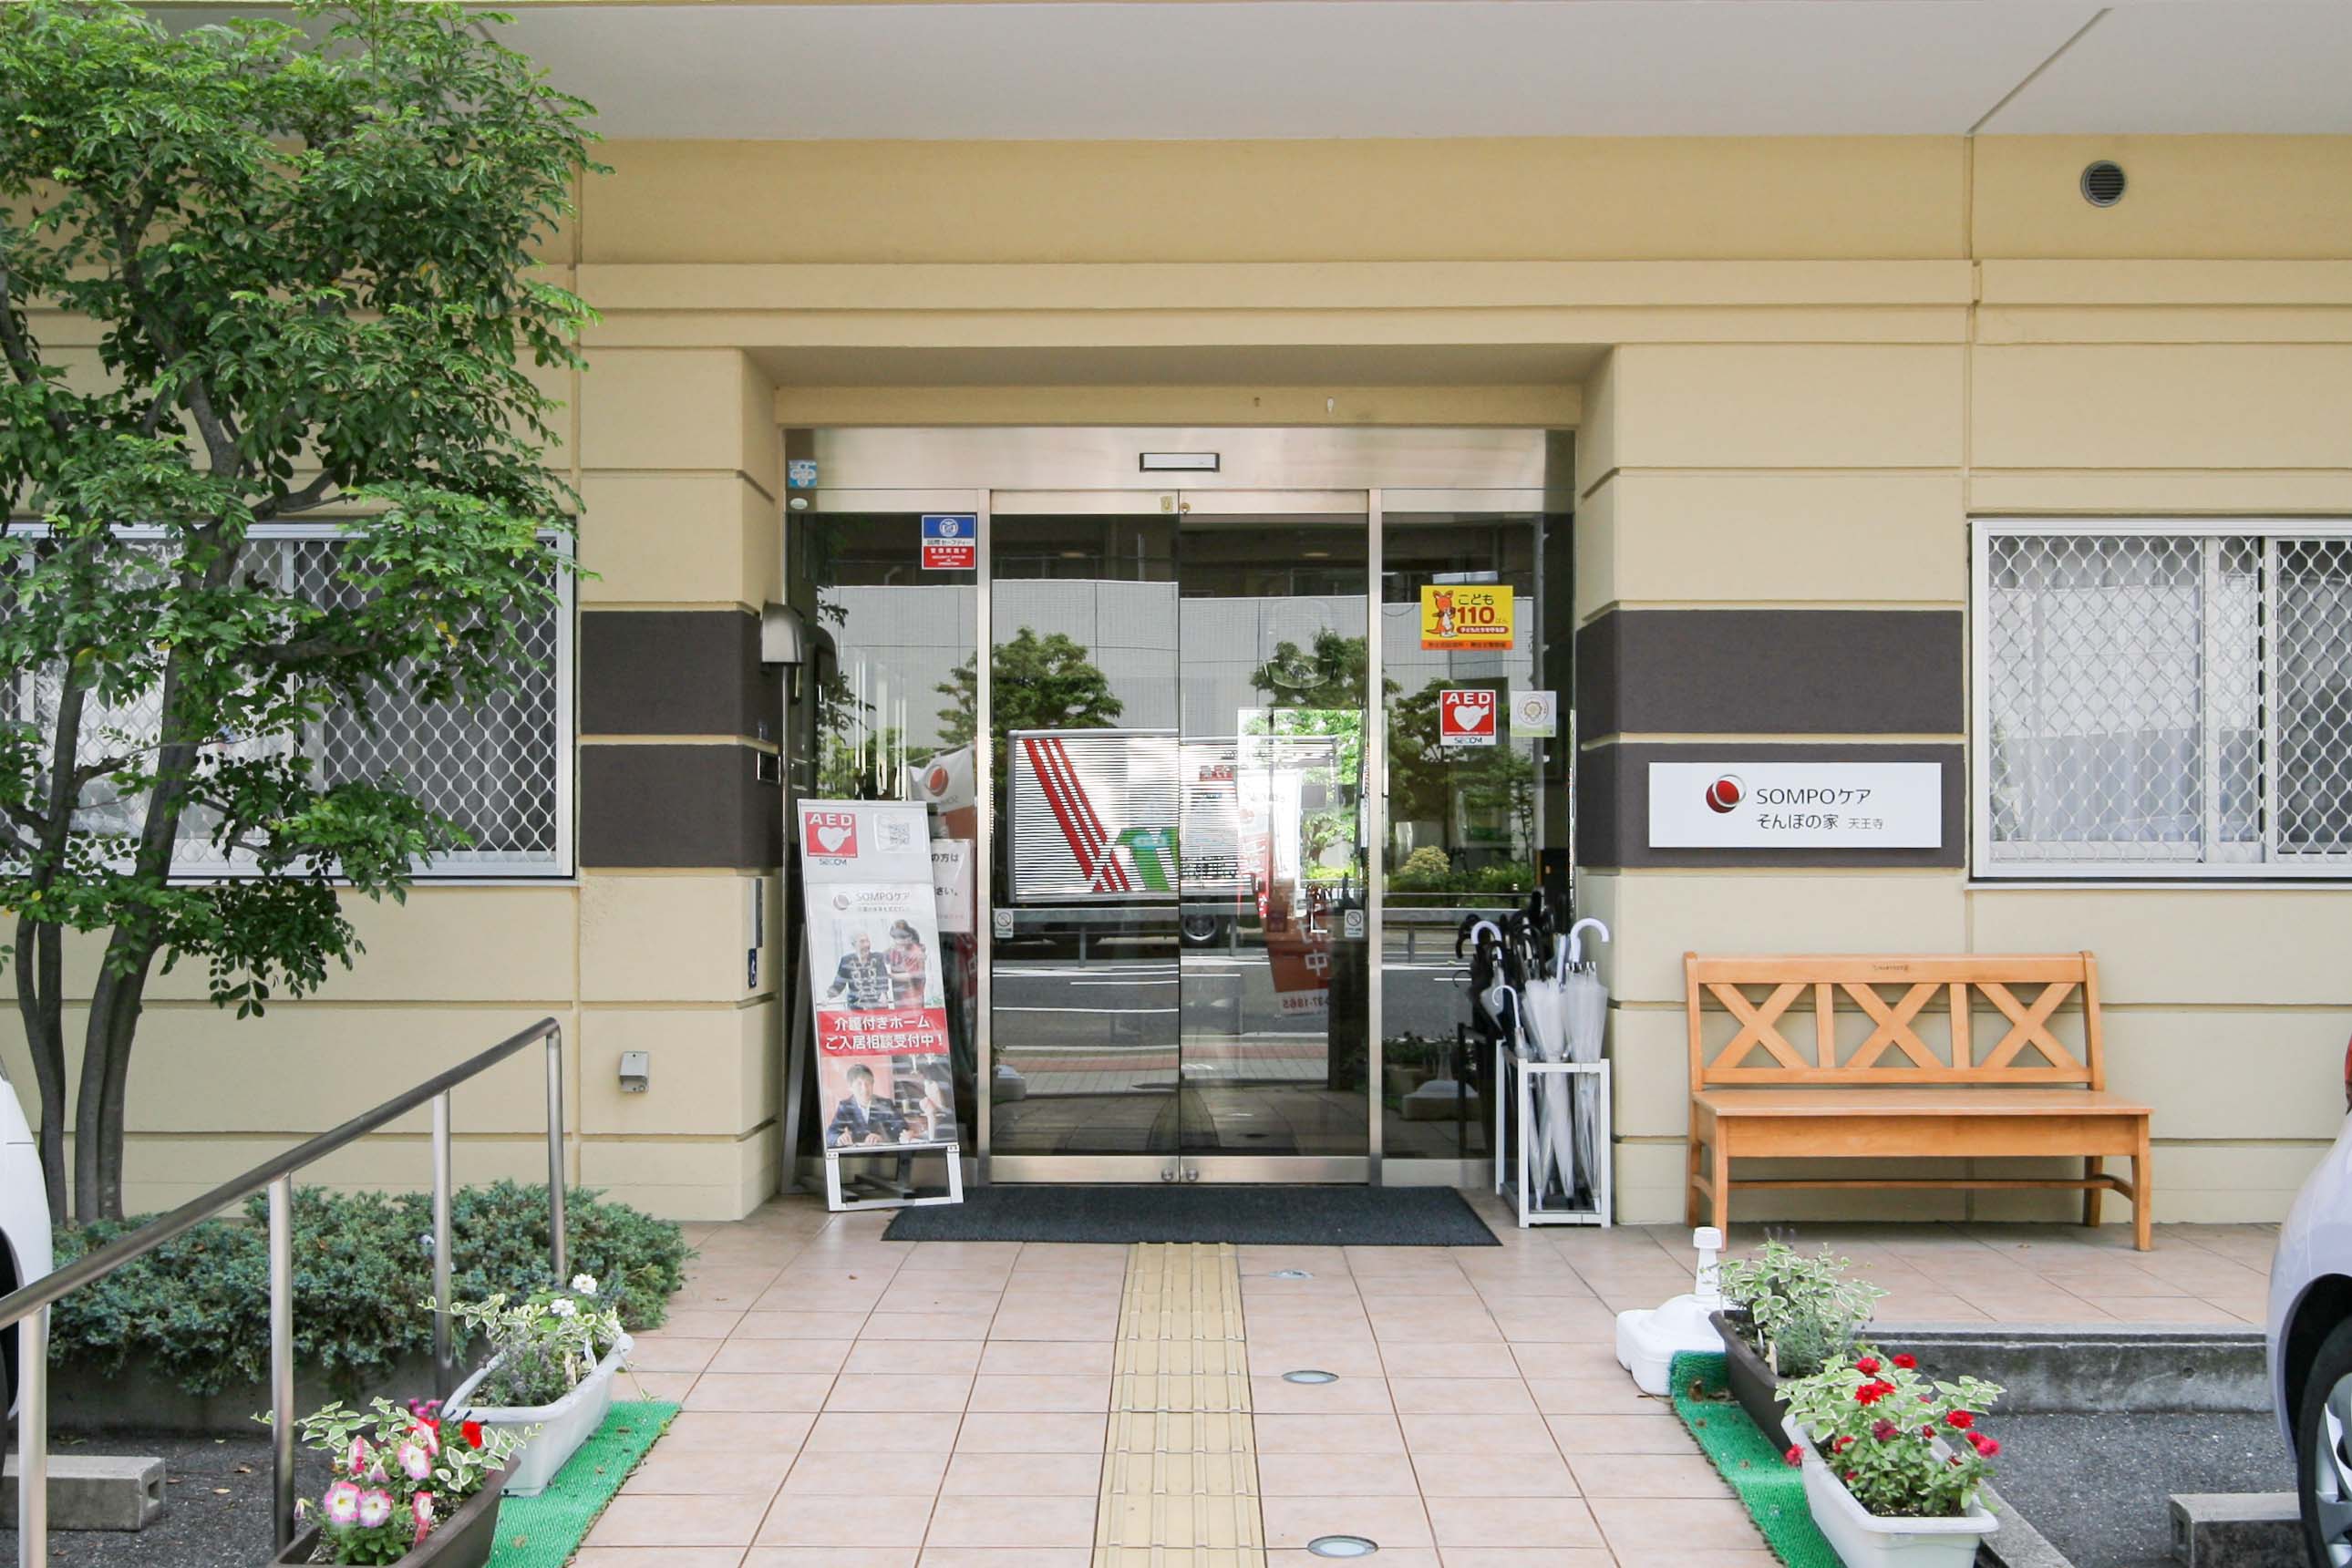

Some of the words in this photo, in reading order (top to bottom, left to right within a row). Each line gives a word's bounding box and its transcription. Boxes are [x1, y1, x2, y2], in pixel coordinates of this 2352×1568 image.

[1458, 593, 1494, 605] こども
[1457, 606, 1495, 624] 110
[1446, 693, 1491, 705] AED
[1757, 788, 1872, 805] SOMPOケア
[810, 813, 853, 826] AED
[1847, 817, 1884, 830] 天王寺
[855, 892, 911, 902] SOMPOケア
[934, 887, 958, 896] さい。
[834, 1015, 931, 1032] 介護付きホーム
